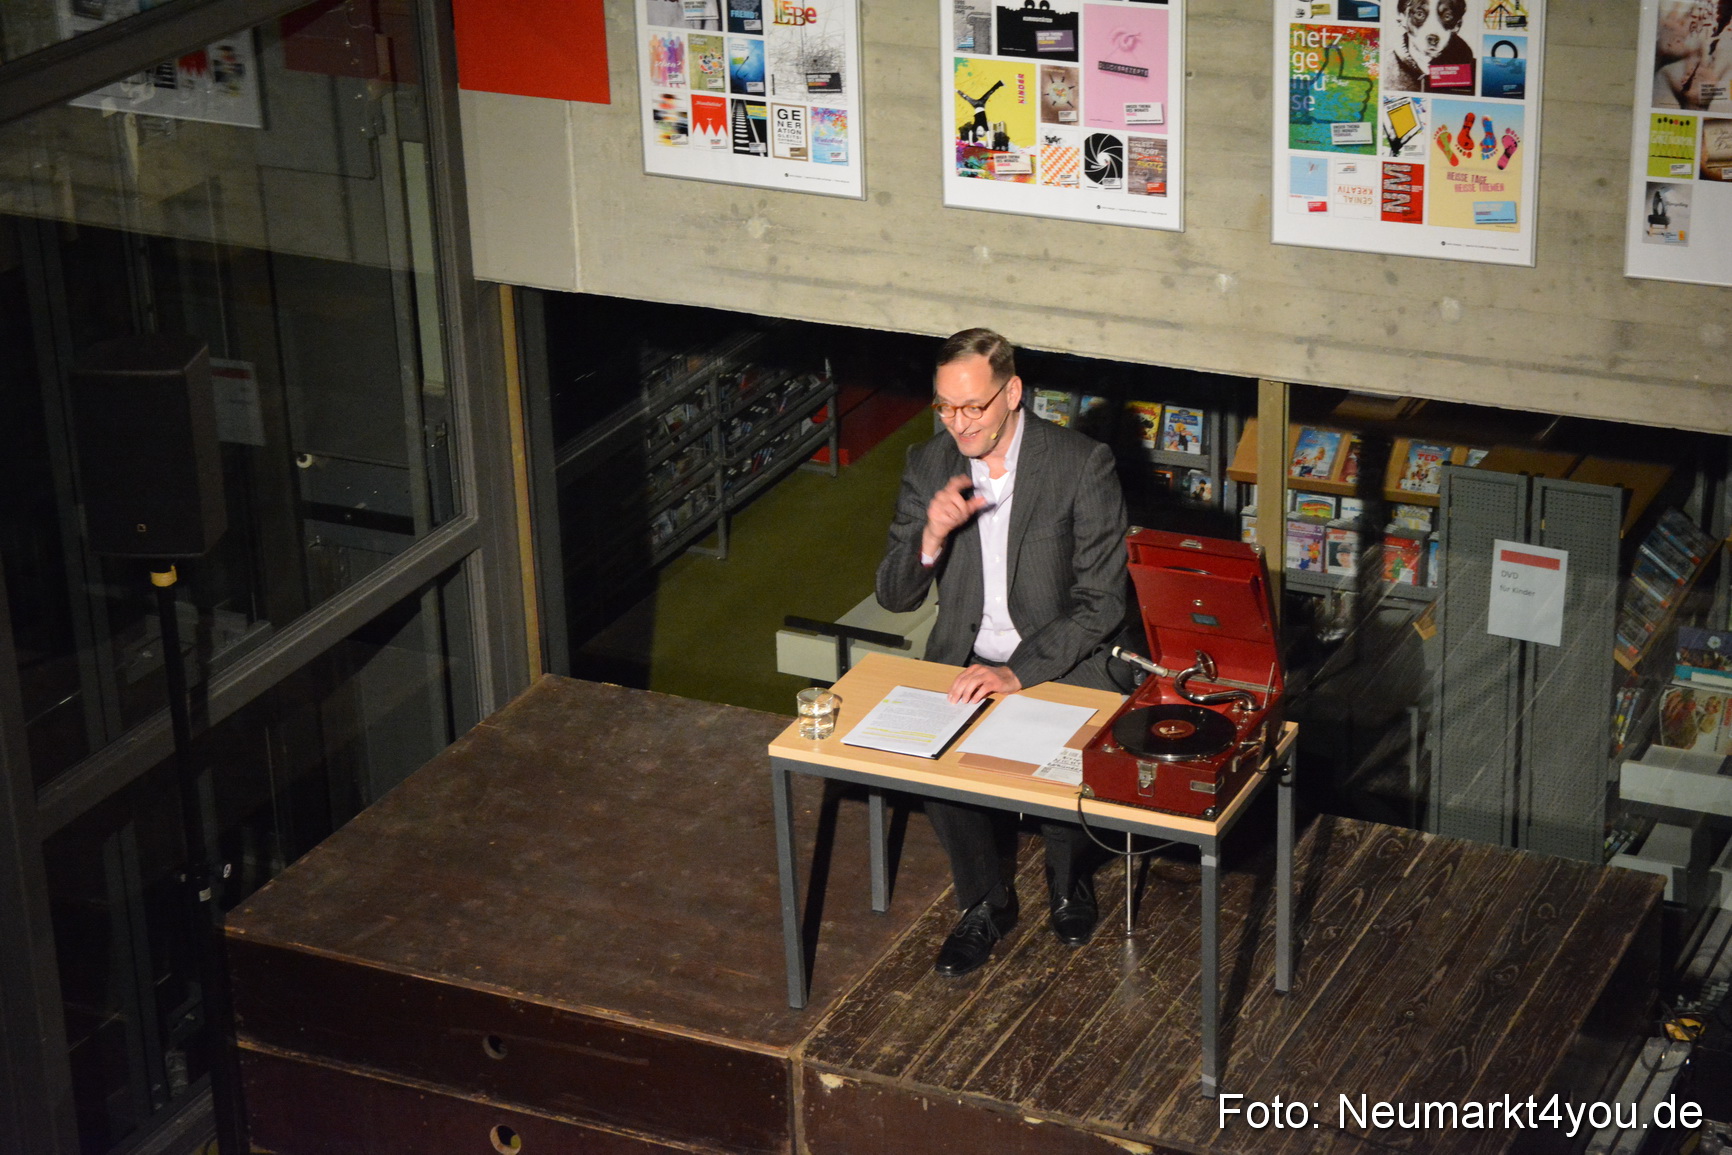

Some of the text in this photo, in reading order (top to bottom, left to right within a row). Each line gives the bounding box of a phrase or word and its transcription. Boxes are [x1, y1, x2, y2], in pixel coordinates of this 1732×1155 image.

[1293, 27, 1343, 49] netz
[1017, 73, 1025, 104] KINDER
[777, 109, 801, 121] GE
[777, 121, 802, 129] NER
[1338, 185, 1374, 195] KREATIV
[1344, 195, 1373, 205] GENIAL
[1501, 570, 1519, 579] DVD
[1512, 587, 1535, 596] Kinder
